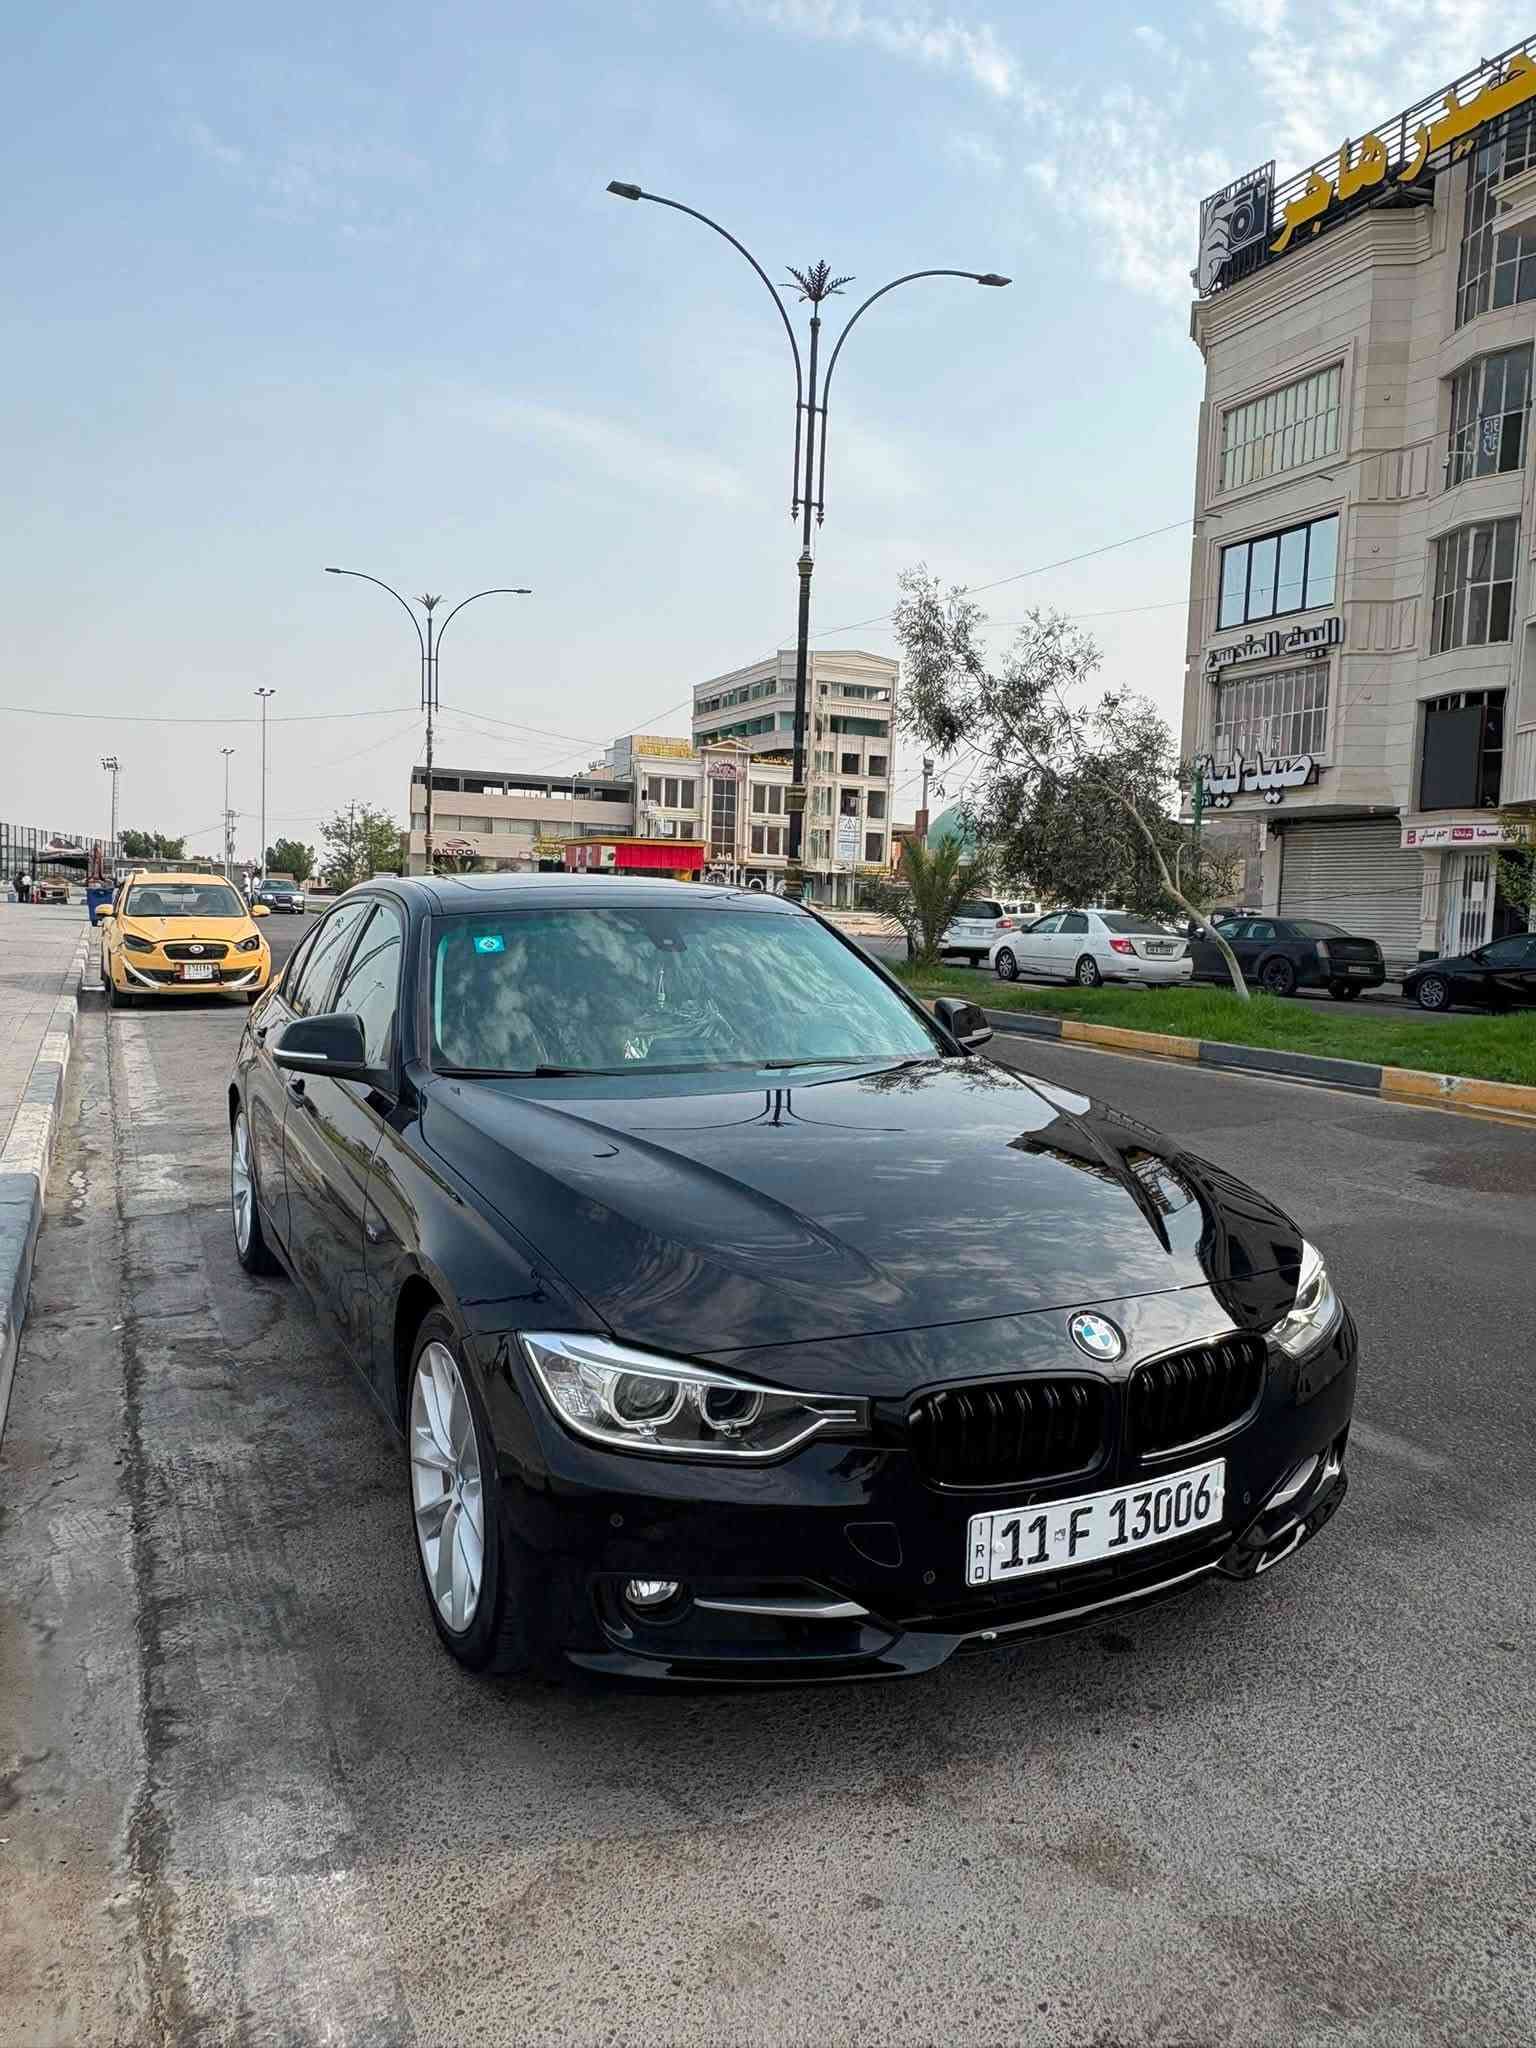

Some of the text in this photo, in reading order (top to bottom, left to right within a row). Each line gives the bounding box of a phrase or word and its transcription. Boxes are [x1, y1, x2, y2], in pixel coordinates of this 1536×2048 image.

[1000, 1473, 1211, 1570] 11 F 13006
